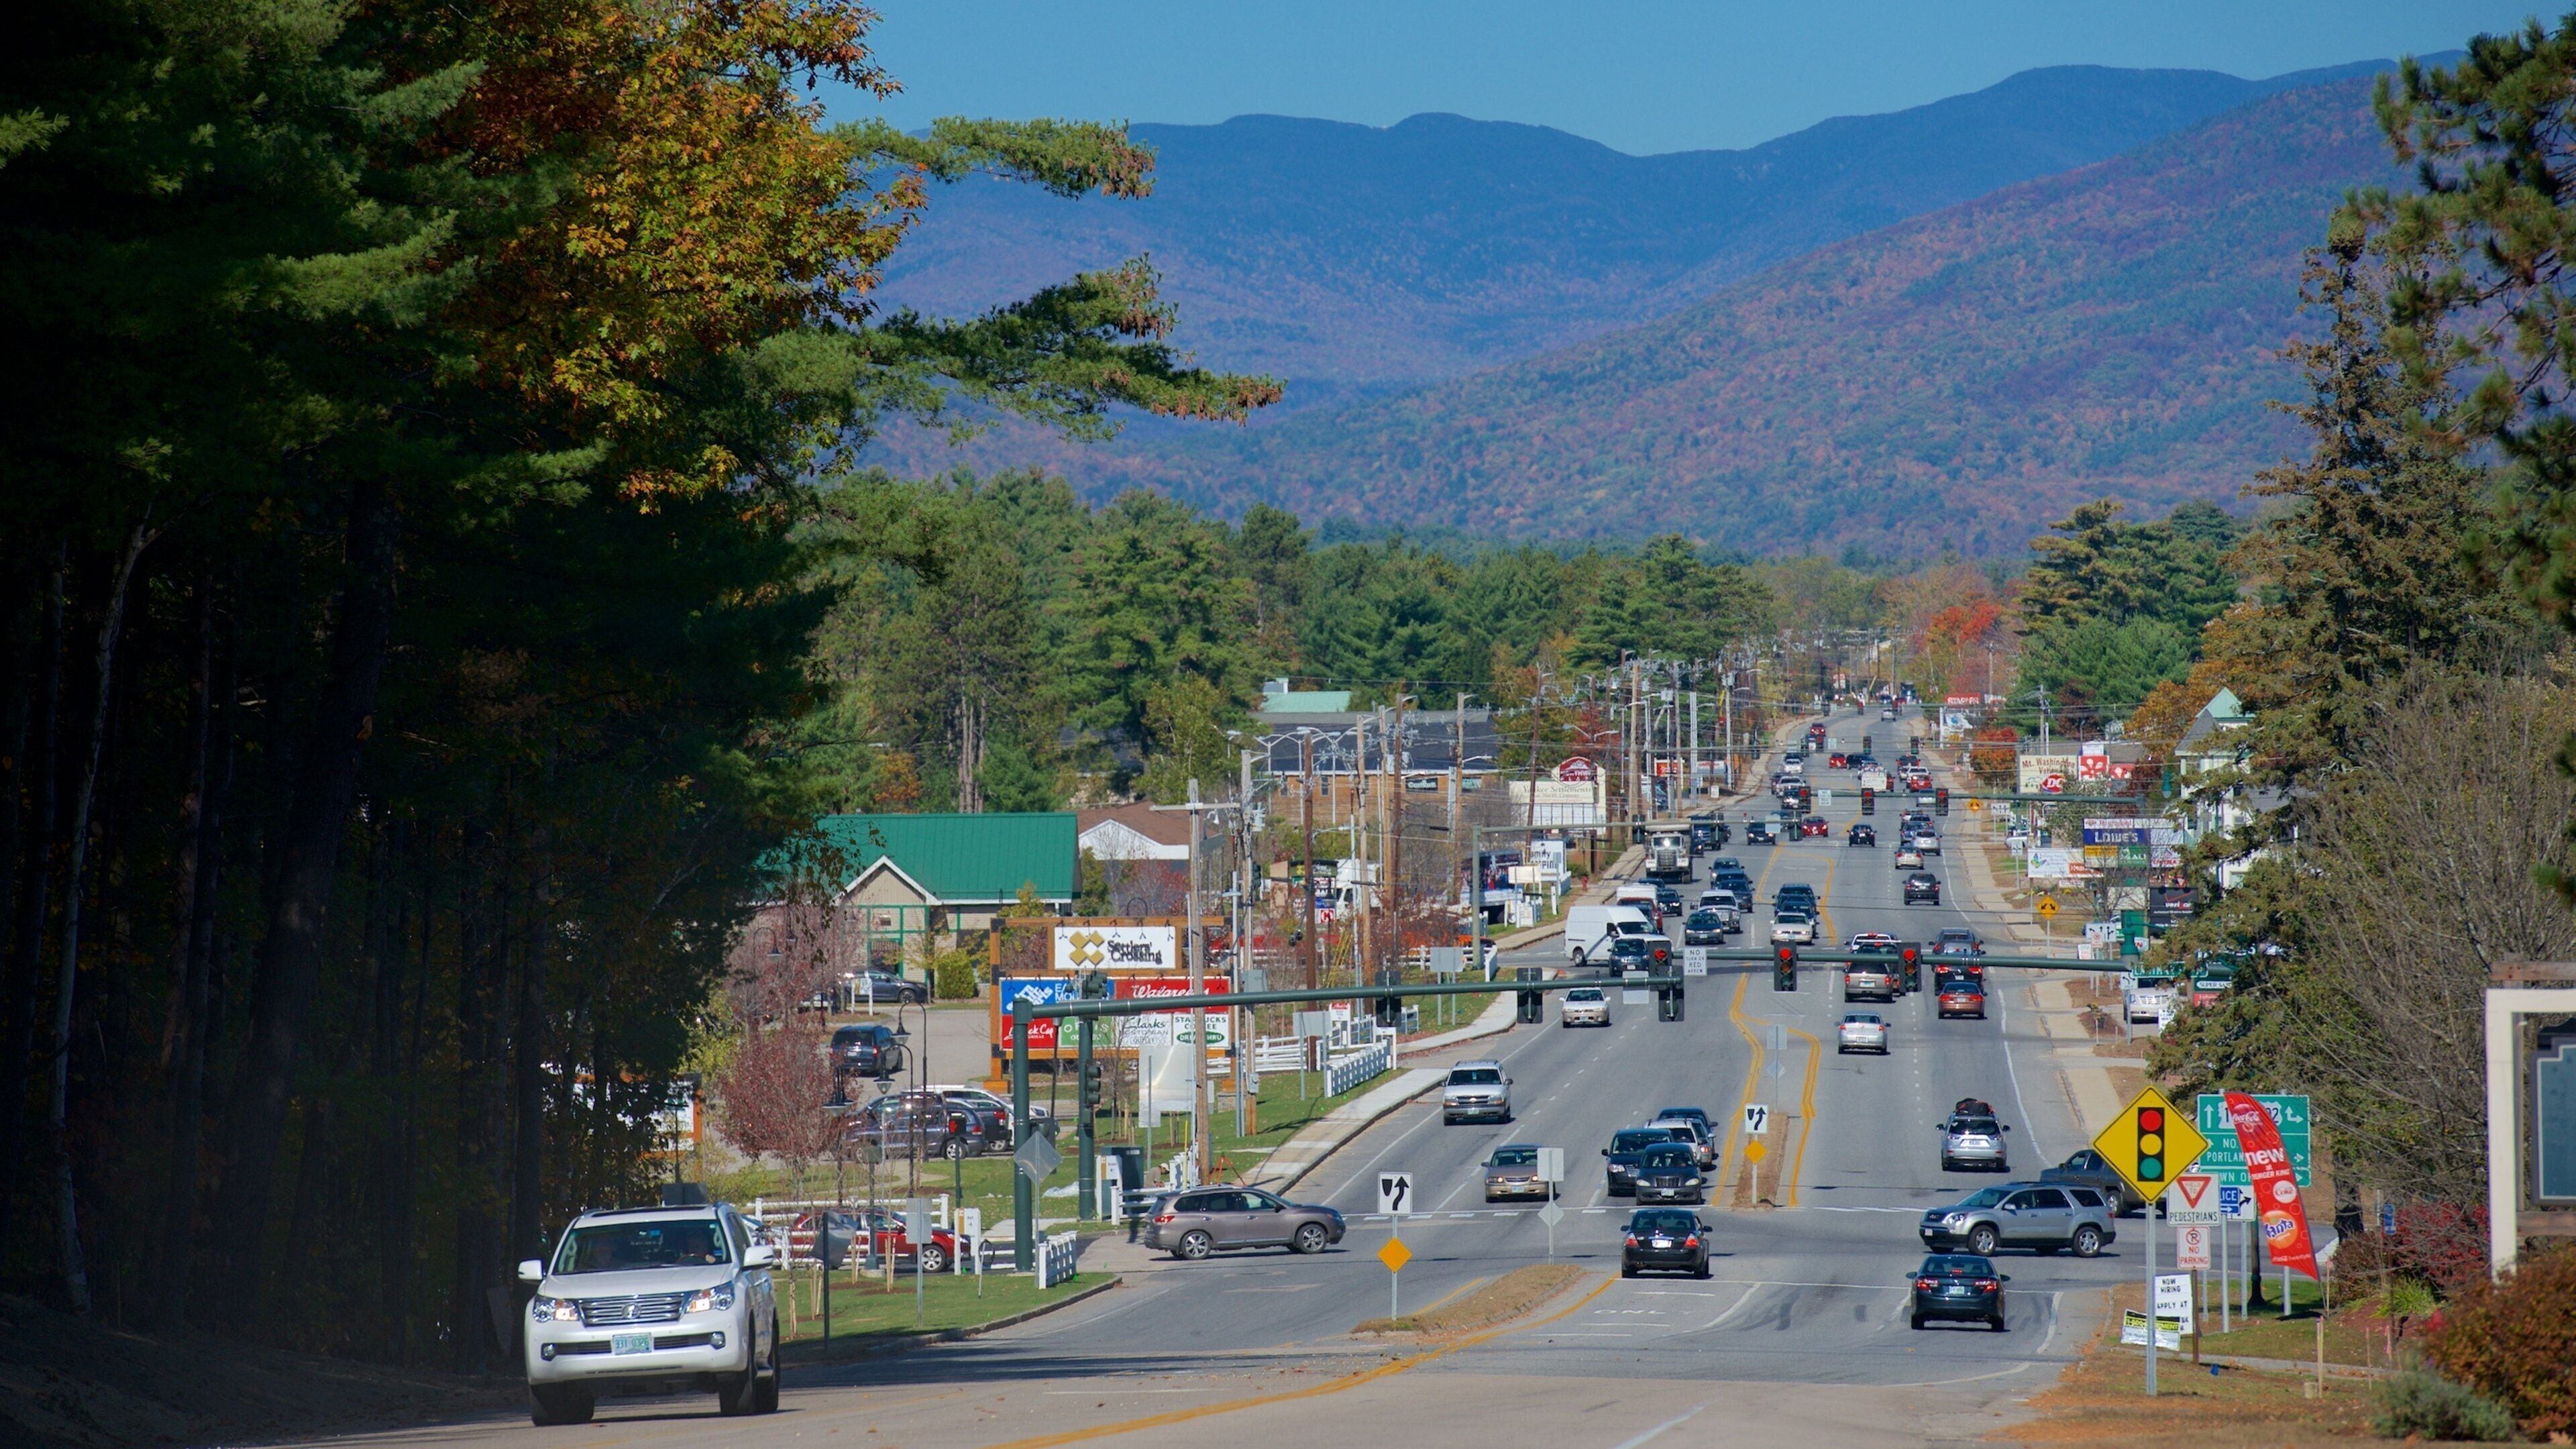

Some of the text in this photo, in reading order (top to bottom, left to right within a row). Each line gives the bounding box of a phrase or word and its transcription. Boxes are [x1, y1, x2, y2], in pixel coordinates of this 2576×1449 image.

[1111, 950, 1163, 965] Crossing
[1124, 1016, 1166, 1029] Clarks
[2206, 1151, 2245, 1162] PORTLAN
[2244, 1147, 2284, 1167] new
[2275, 1169, 2290, 1177] KING
[2169, 1212, 2218, 1222] PEDESTRIANS
[2180, 1256, 2208, 1265] PARKING
[2161, 1285, 2181, 1293] HIRING
